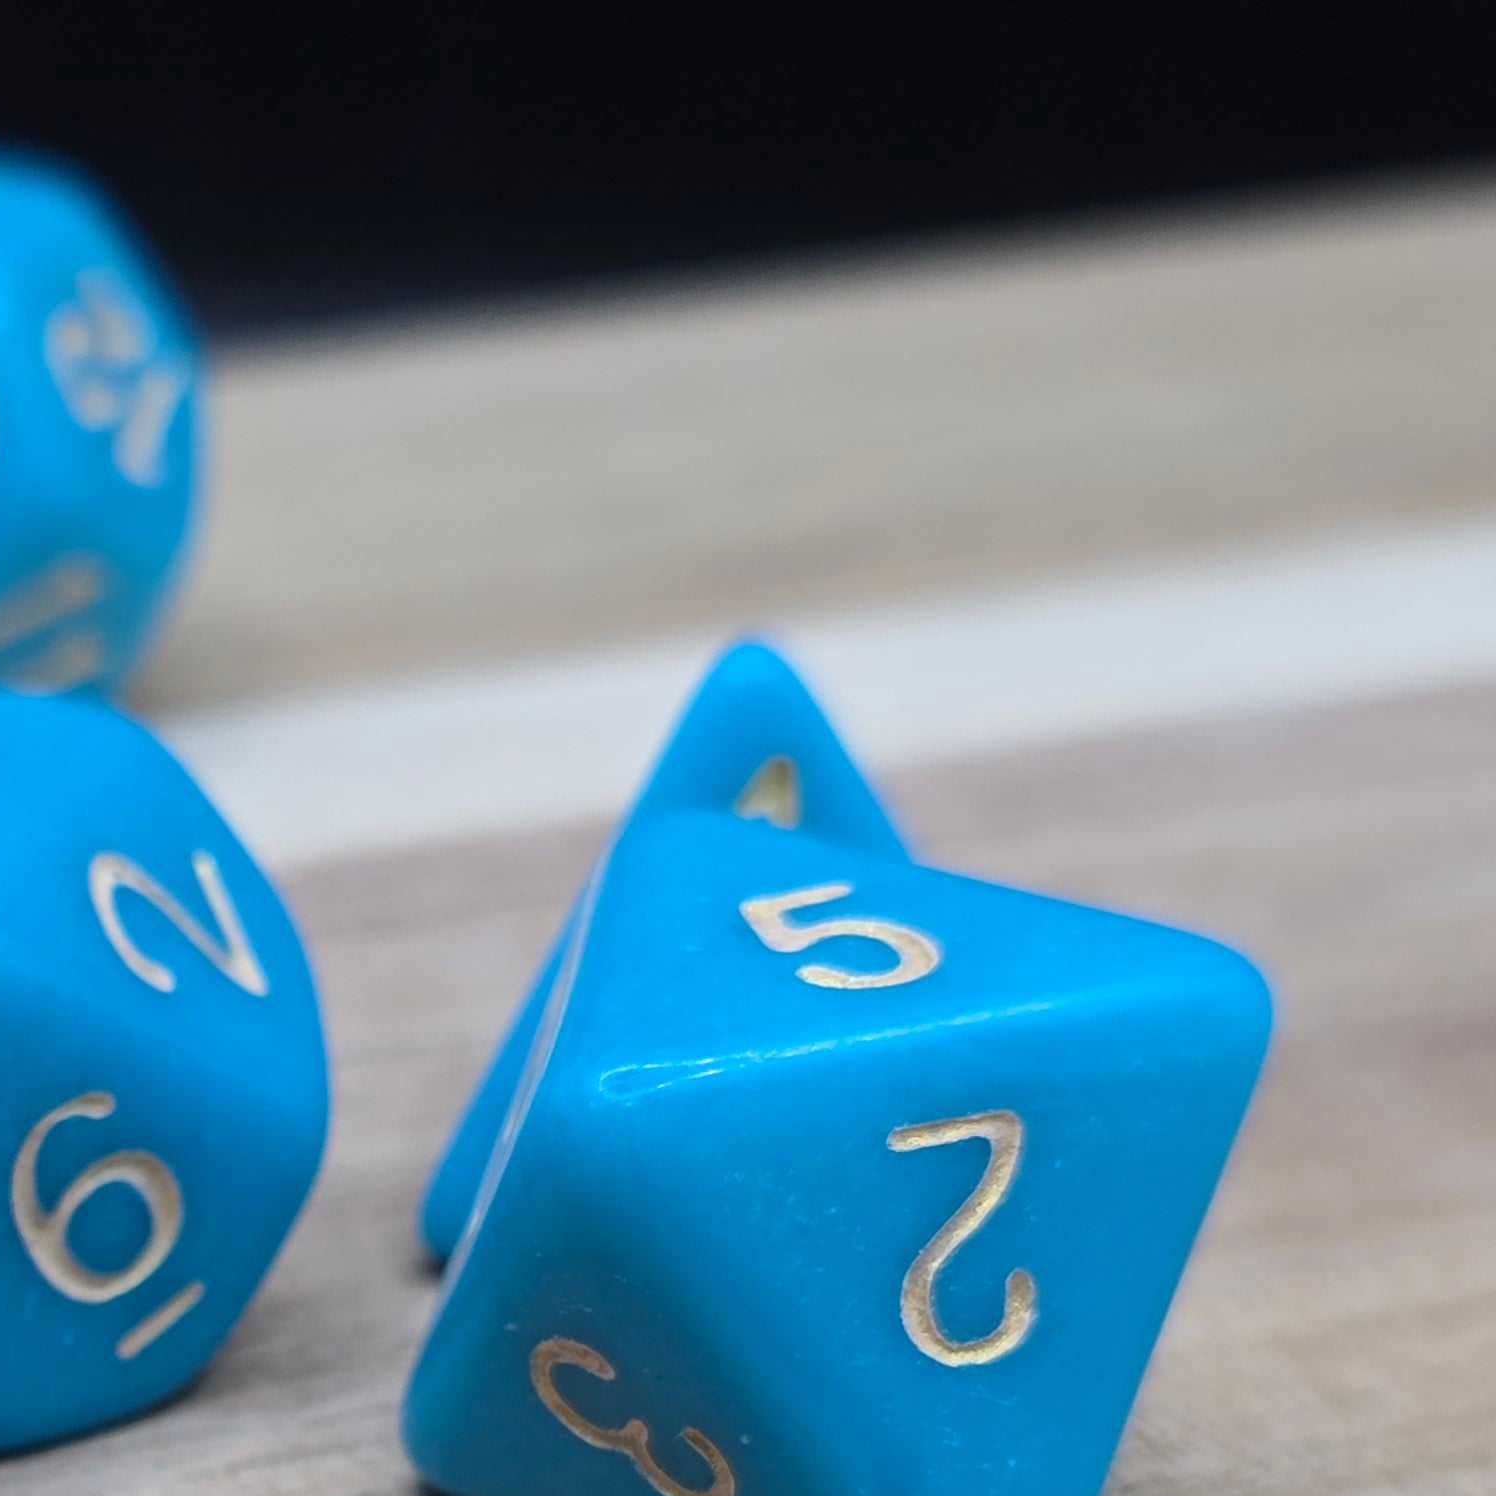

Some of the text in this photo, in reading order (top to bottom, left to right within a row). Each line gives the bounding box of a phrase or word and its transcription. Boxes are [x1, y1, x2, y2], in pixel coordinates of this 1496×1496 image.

[86, 850, 270, 998] 2
[740, 882, 942, 990] 5
[886, 1109, 1037, 1368] 2
